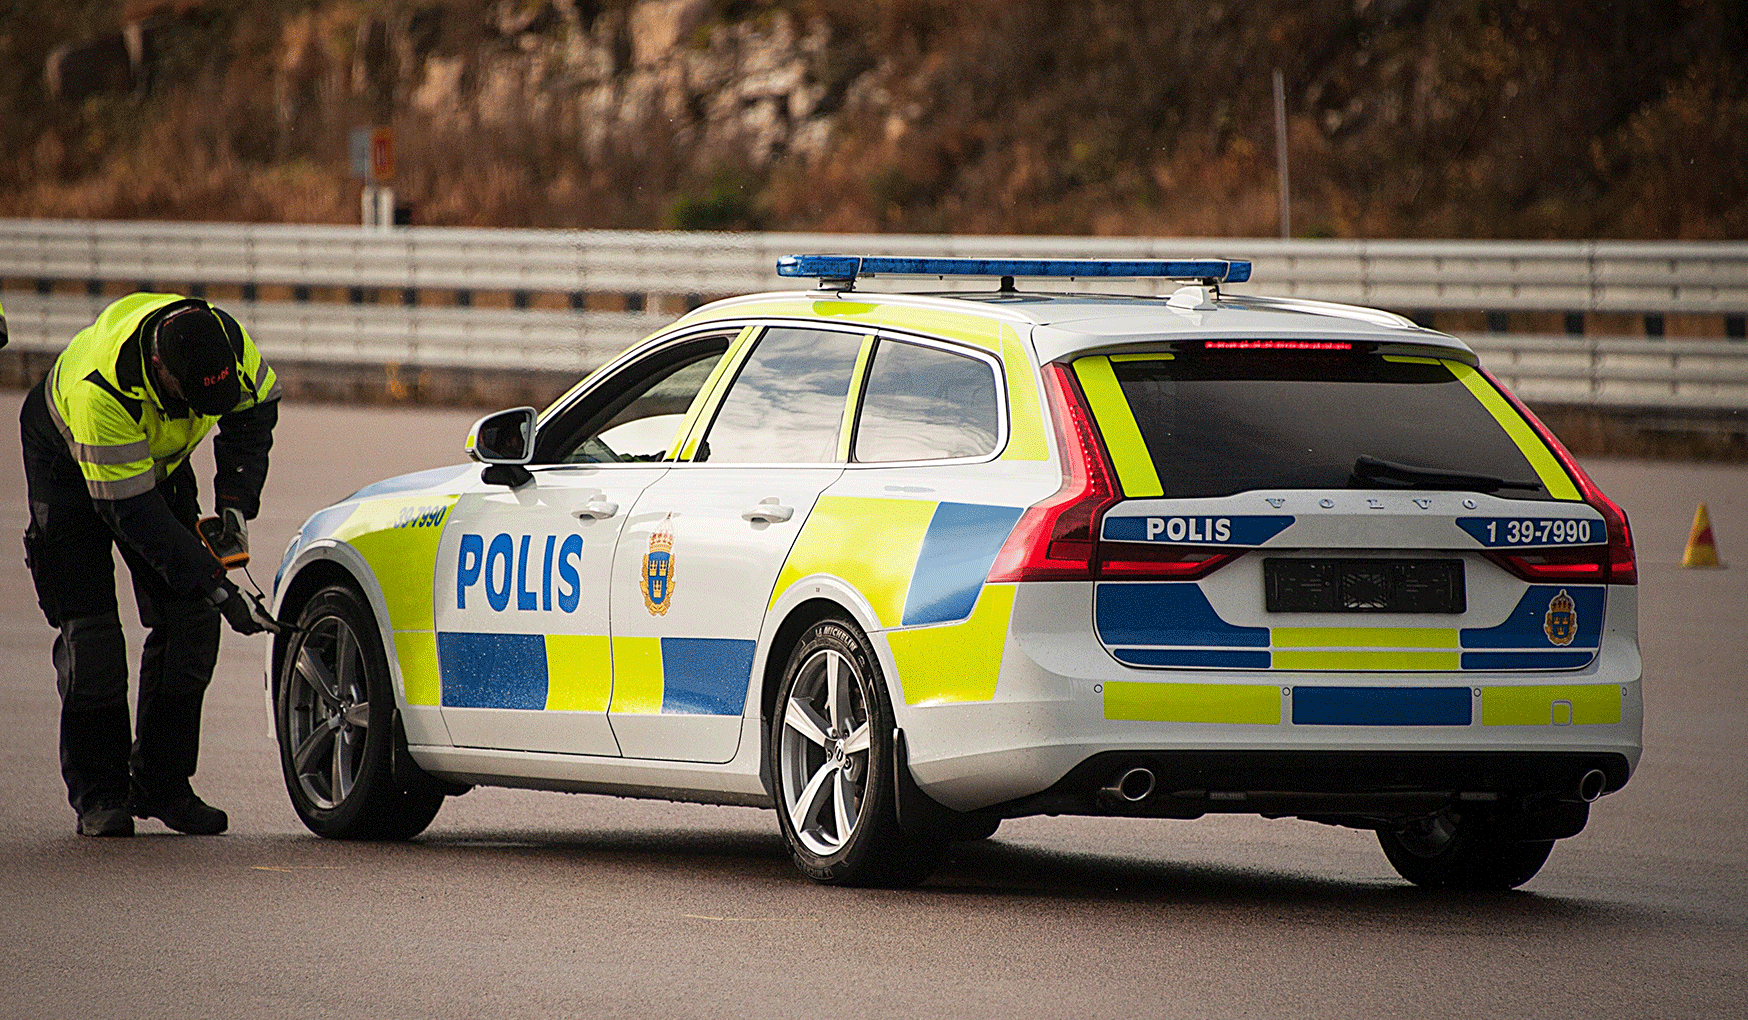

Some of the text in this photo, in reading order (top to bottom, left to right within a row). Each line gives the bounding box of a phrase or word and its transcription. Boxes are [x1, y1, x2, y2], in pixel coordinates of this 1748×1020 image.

[1265, 498, 1478, 510] VOLVO
[1146, 517, 1231, 542] POLIS
[1486, 520, 1591, 543] 1 39-7990
[457, 532, 584, 614] POLIS
[823, 626, 859, 652] MICHELIN
